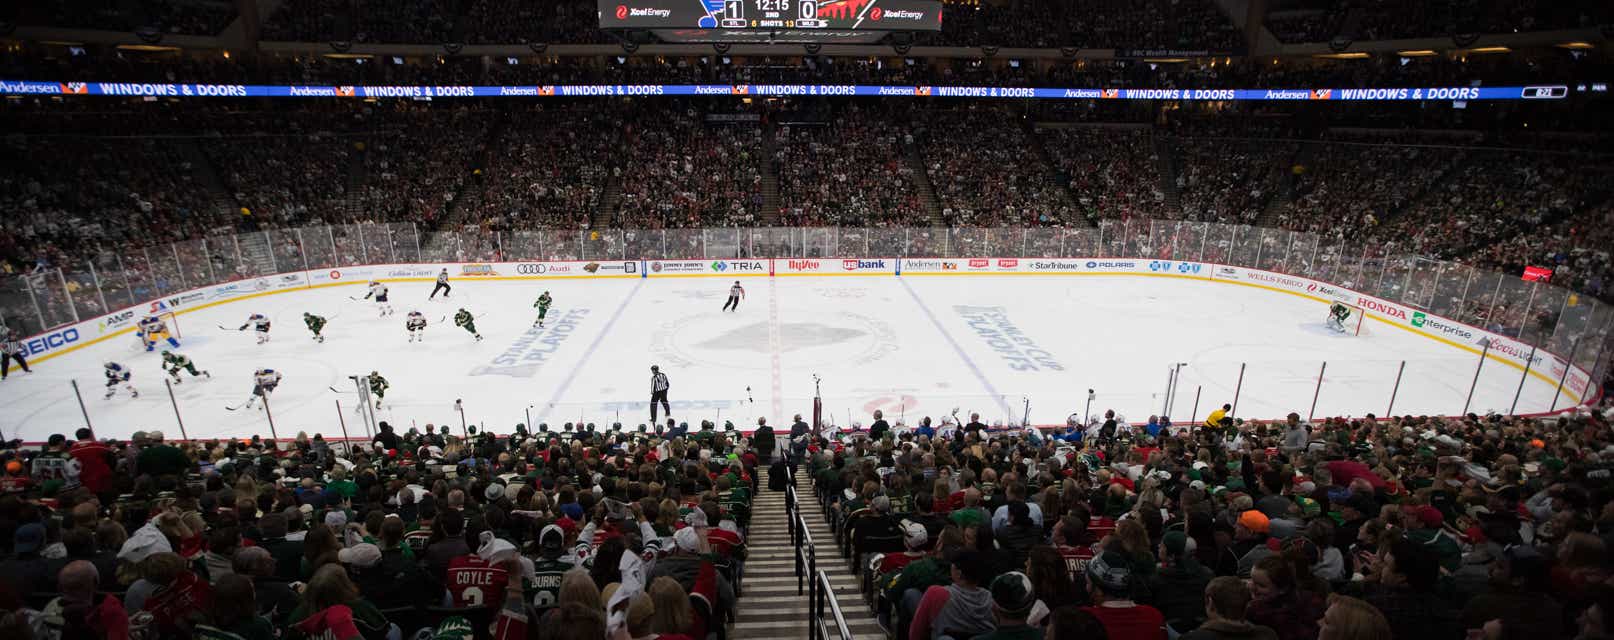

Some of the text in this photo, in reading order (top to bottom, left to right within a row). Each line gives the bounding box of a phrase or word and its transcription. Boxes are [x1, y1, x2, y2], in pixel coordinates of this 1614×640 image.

[729, 2, 738, 18] 1
[755, 0, 789, 10] 12:15
[802, 2, 814, 19] 0
[630, 8, 671, 17] Xcel Energy
[900, 10, 923, 19] Energy
[0, 82, 247, 96] Andersen WINDOWS & DOORS
[290, 86, 474, 97] Andersen WINDOWS & DOORS
[501, 85, 664, 96] Andersen WINDOWS & DOORS
[694, 85, 856, 95] Andersen WINDOWS & DOORS
[878, 86, 1035, 97] Andersen WINDOWS & DOORS
[1064, 88, 1235, 100] Andersen WINDOWS & DOORS
[1264, 88, 1479, 100] Andersen WINDOWS & DOORS
[731, 262, 763, 270] TRIA
[905, 259, 941, 270] Andersen
[1247, 272, 1276, 284] WELLS
[1276, 277, 1304, 288] FARGO
[1357, 297, 1407, 320] HONDA
[107, 311, 134, 326] AMP
[1416, 316, 1472, 339] enterprise
[1490, 337, 1518, 356] Coors
[456, 571, 493, 585] COYLE
